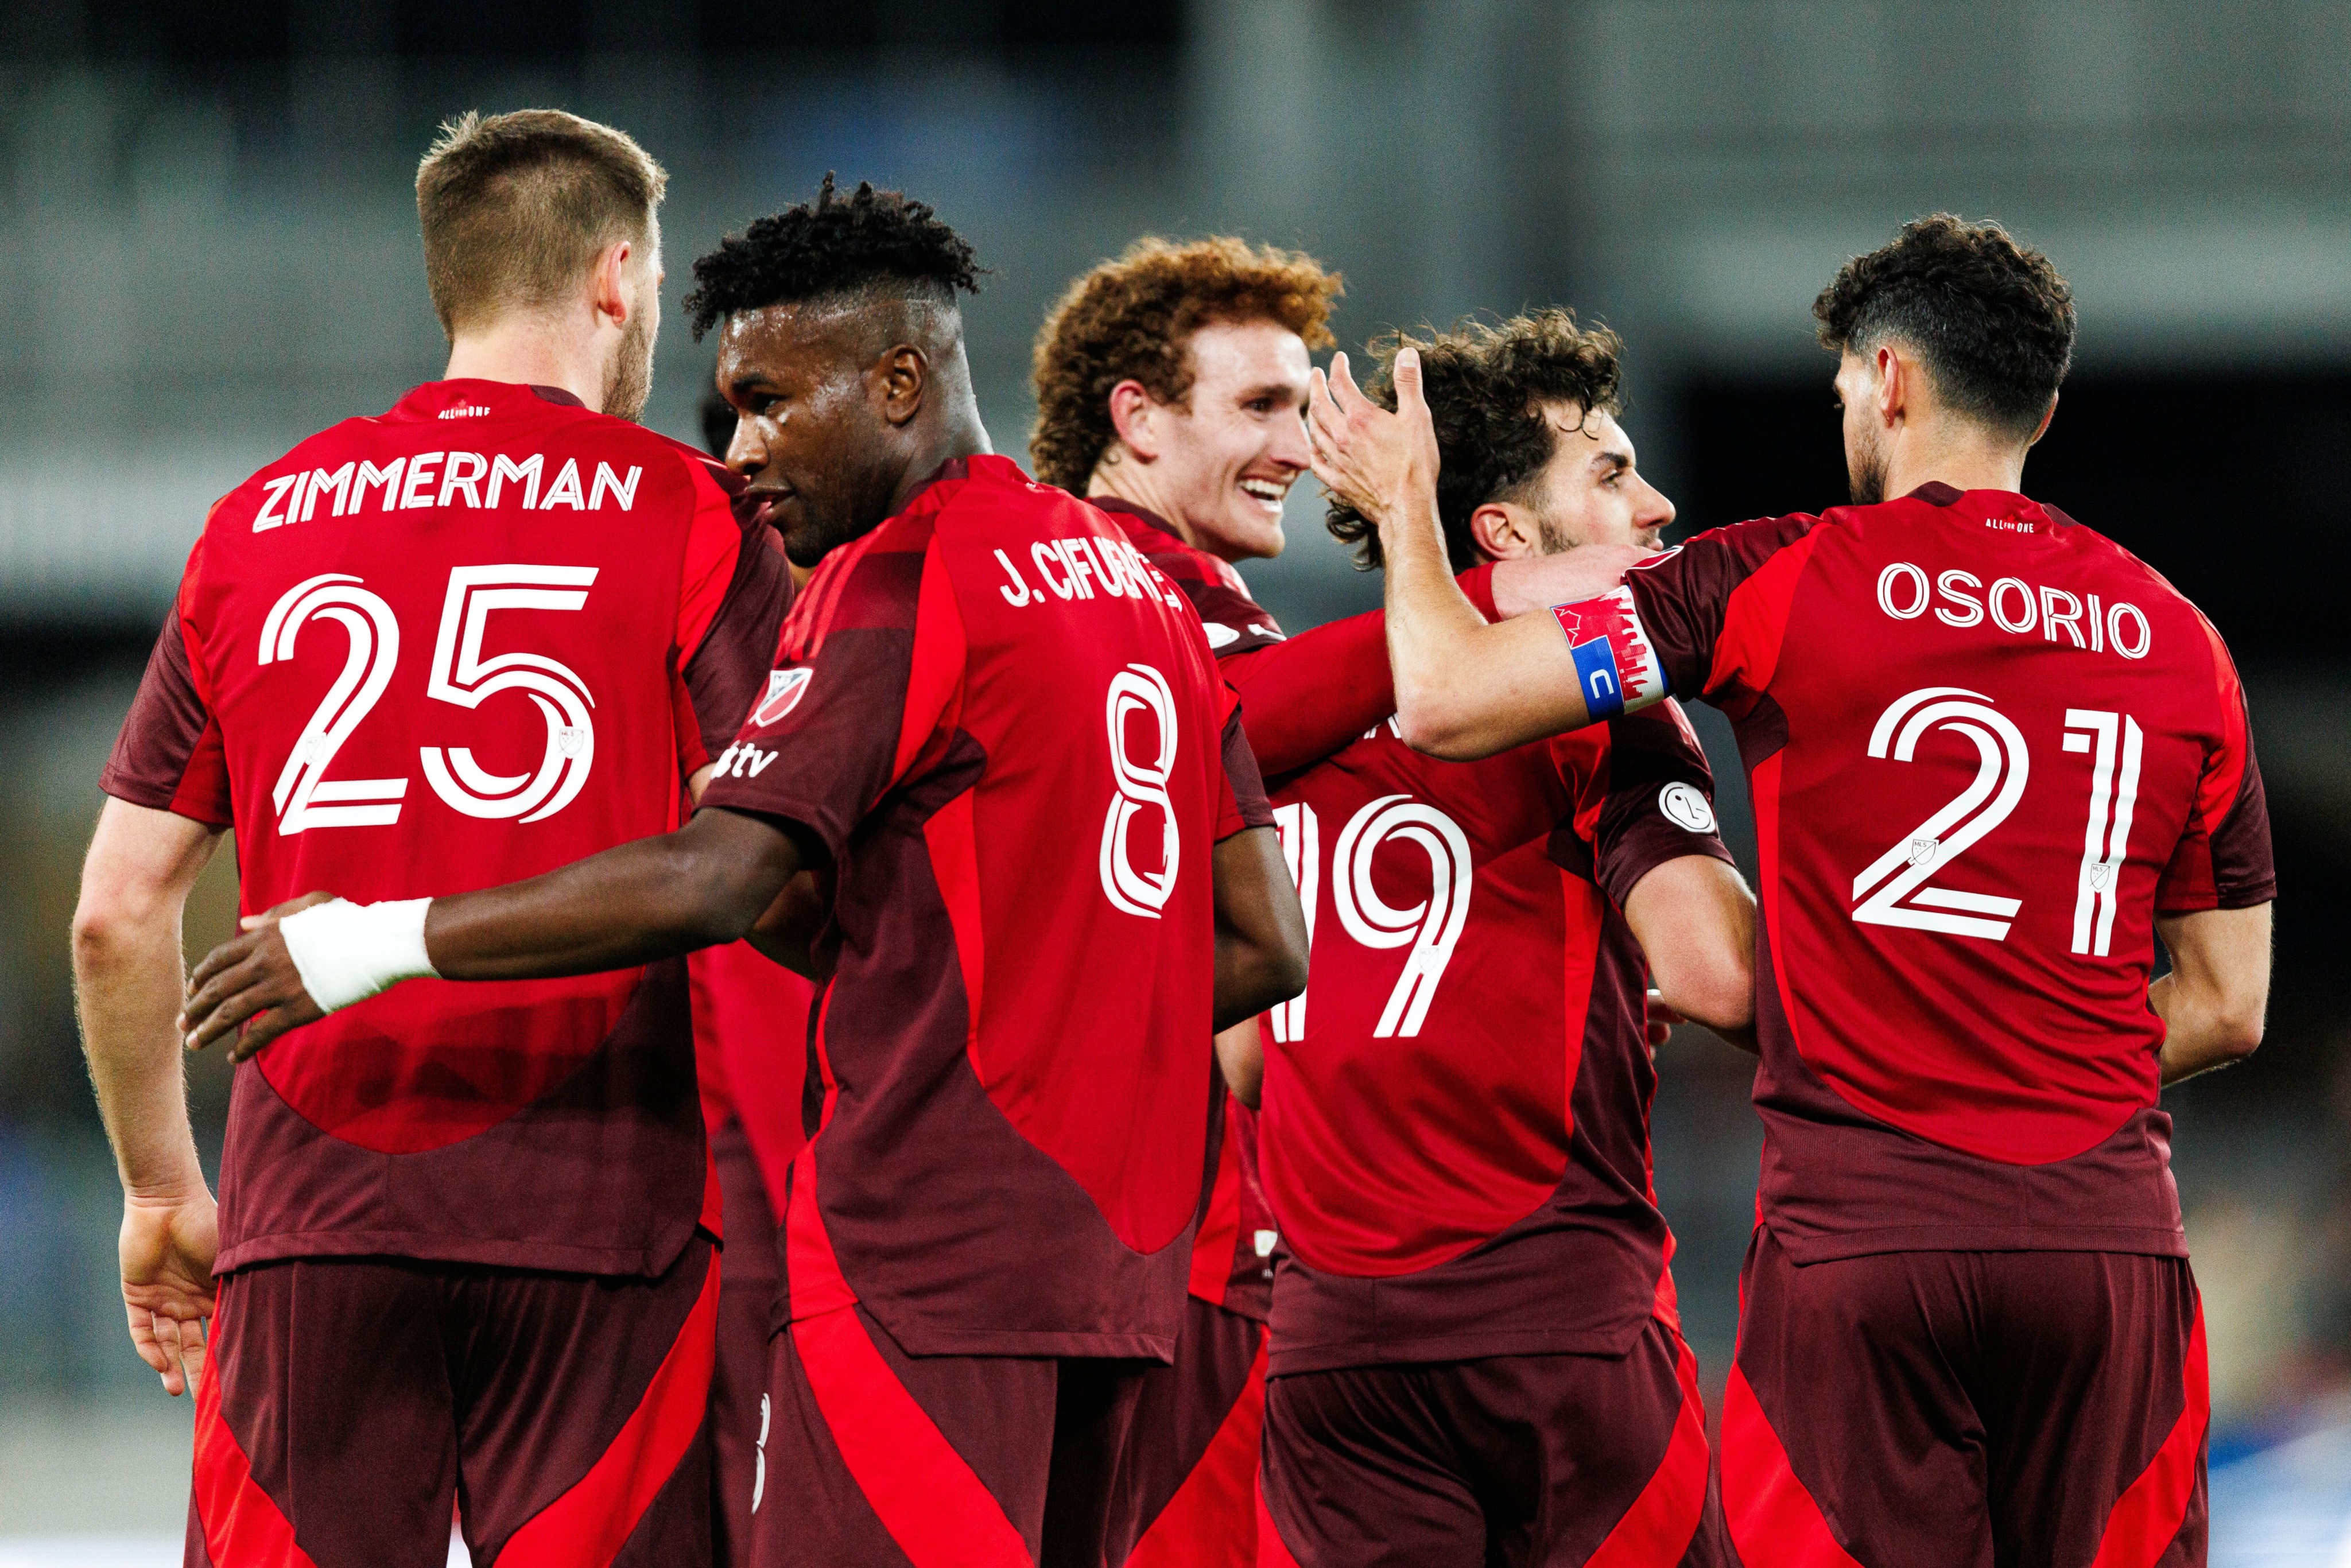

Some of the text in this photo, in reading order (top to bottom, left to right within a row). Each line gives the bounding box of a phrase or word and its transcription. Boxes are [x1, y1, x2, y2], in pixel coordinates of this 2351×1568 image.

[253, 451, 642, 533] ZIMMERMAN
[1985, 518, 2004, 530] ALL
[2016, 523, 2034, 533] ONE
[1877, 561, 2151, 659] OSORIO
[258, 564, 599, 836] 25
[1589, 669, 1615, 699] C
[1100, 663, 1180, 919] 8
[1852, 687, 2143, 957] 21
